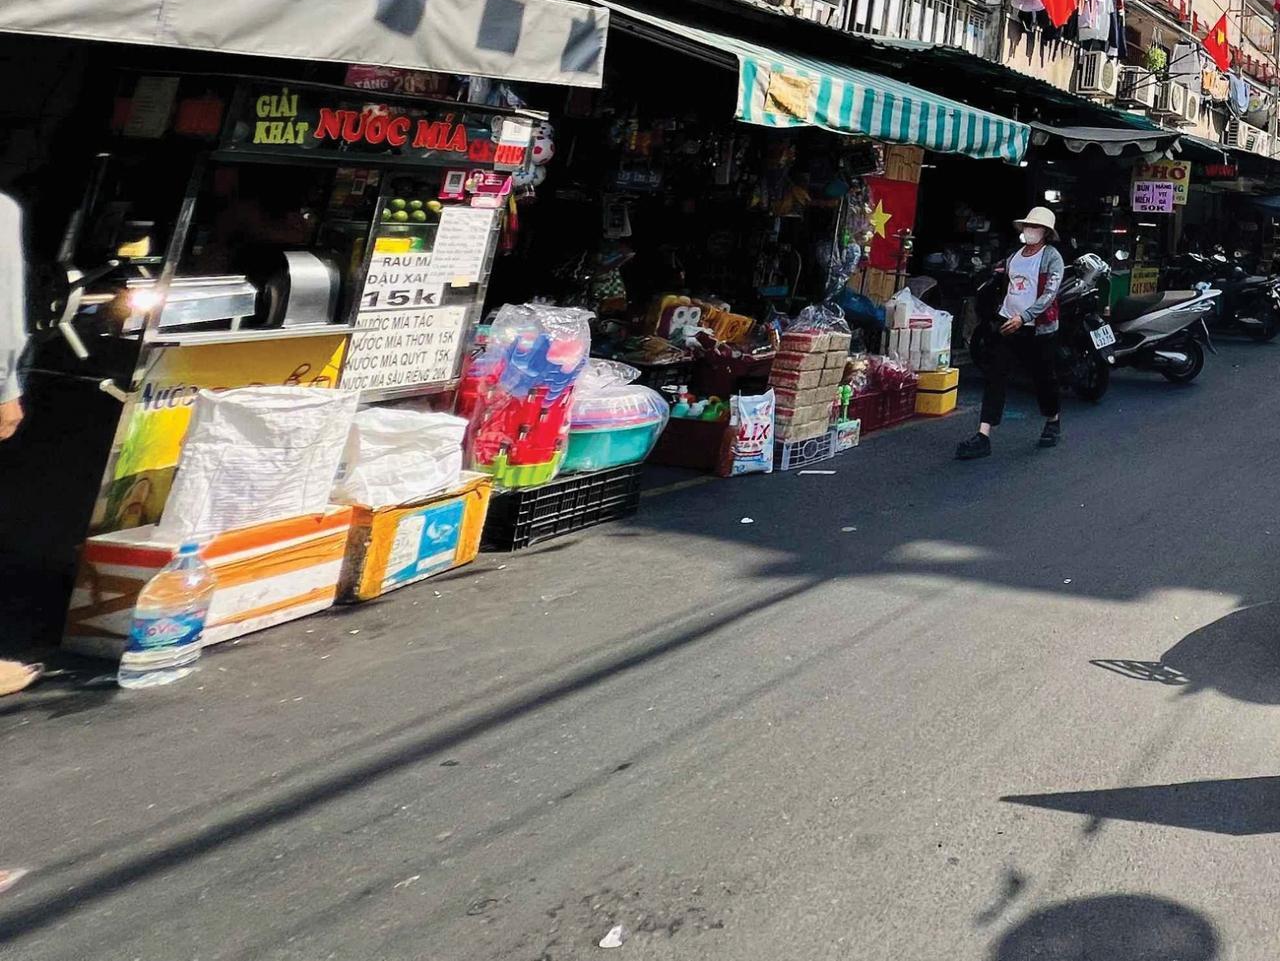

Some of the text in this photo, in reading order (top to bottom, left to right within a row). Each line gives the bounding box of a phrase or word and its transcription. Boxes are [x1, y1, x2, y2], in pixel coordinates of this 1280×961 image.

[255, 87, 299, 118] GIẢI
[253, 120, 309, 145] KHÁT
[314, 104, 410, 146] NƯỚC
[412, 114, 468, 152] MÍA
[1137, 161, 1188, 180] PHỞ
[383, 257, 412, 267] RAU
[391, 315, 410, 328] MÍA
[383, 334, 405, 349] MÍA
[406, 332, 434, 346] THƠM
[437, 331, 455, 344] 15K
[378, 352, 398, 367] MÍA
[433, 349, 449, 363] 15K
[370, 372, 386, 387] MÍA
